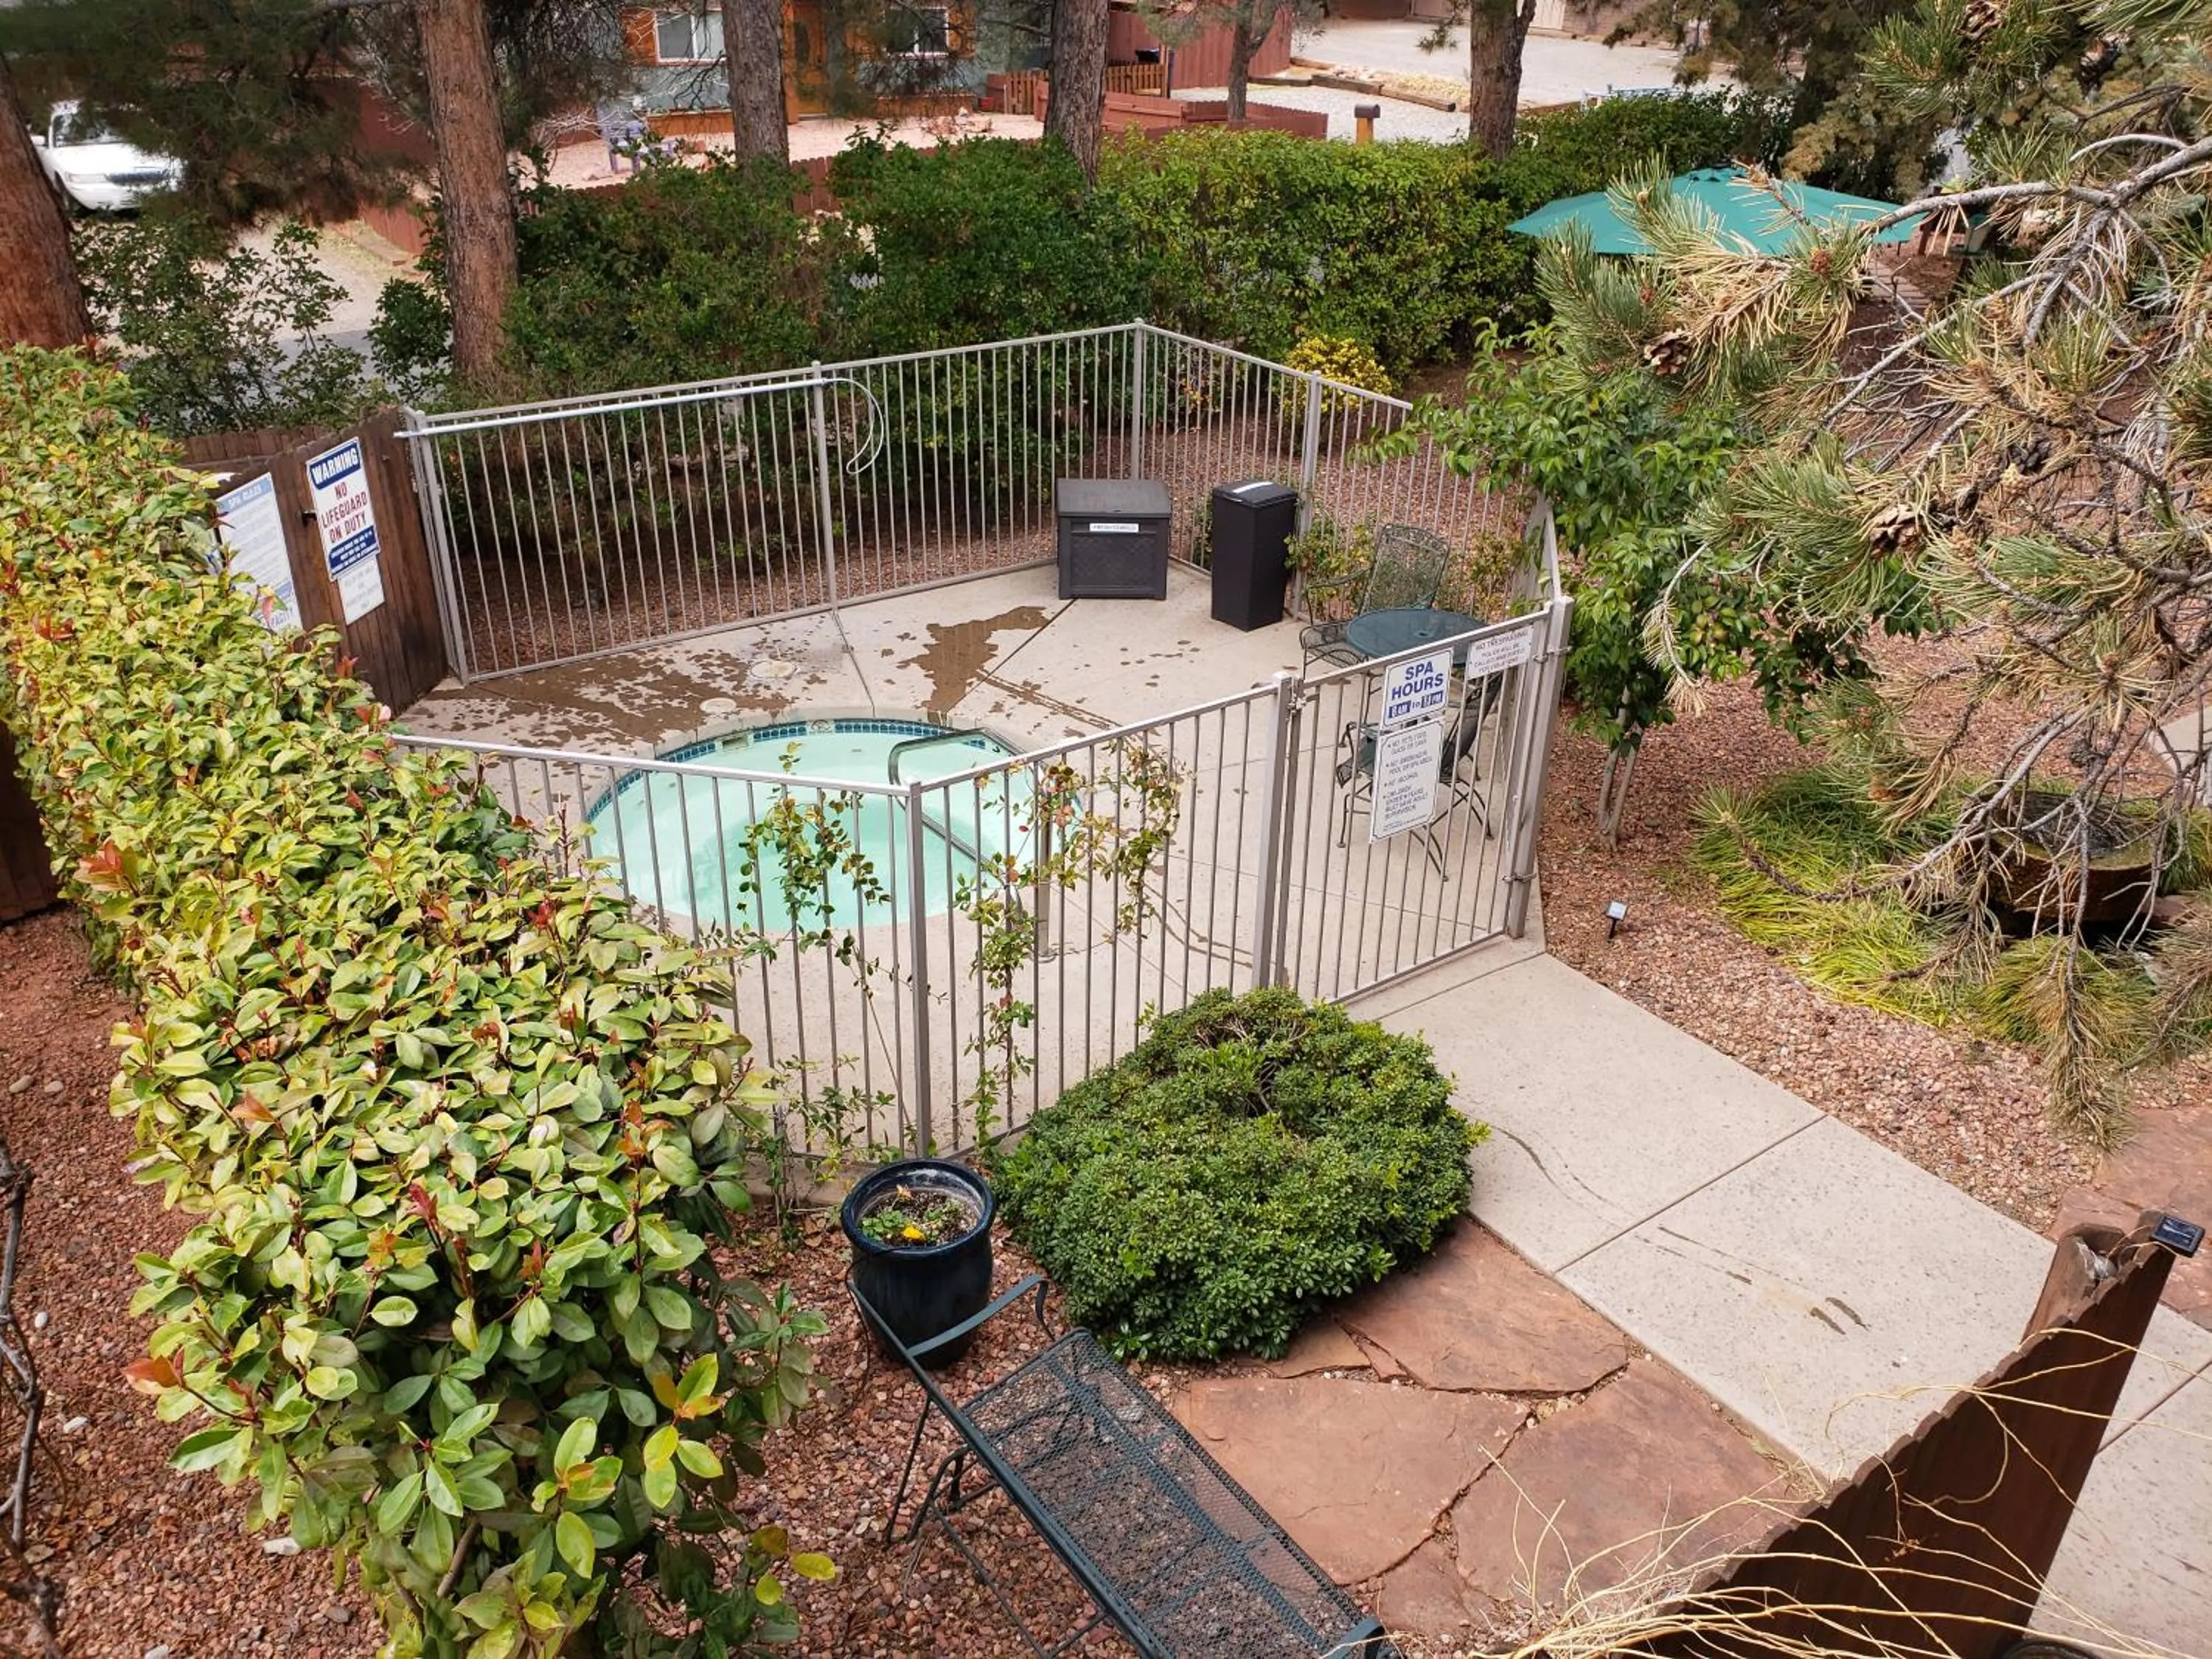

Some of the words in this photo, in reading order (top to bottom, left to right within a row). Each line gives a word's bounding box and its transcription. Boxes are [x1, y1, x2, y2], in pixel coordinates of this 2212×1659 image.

[313, 448, 358, 484] WARNING
[335, 482, 347, 500] NO
[321, 492, 367, 527] LIFEGUARD
[330, 525, 342, 543] ON
[344, 511, 366, 535] DUTY
[1405, 661, 1433, 680] SPA
[1391, 673, 1444, 700] HOURS
[1399, 703, 1409, 716] AM
